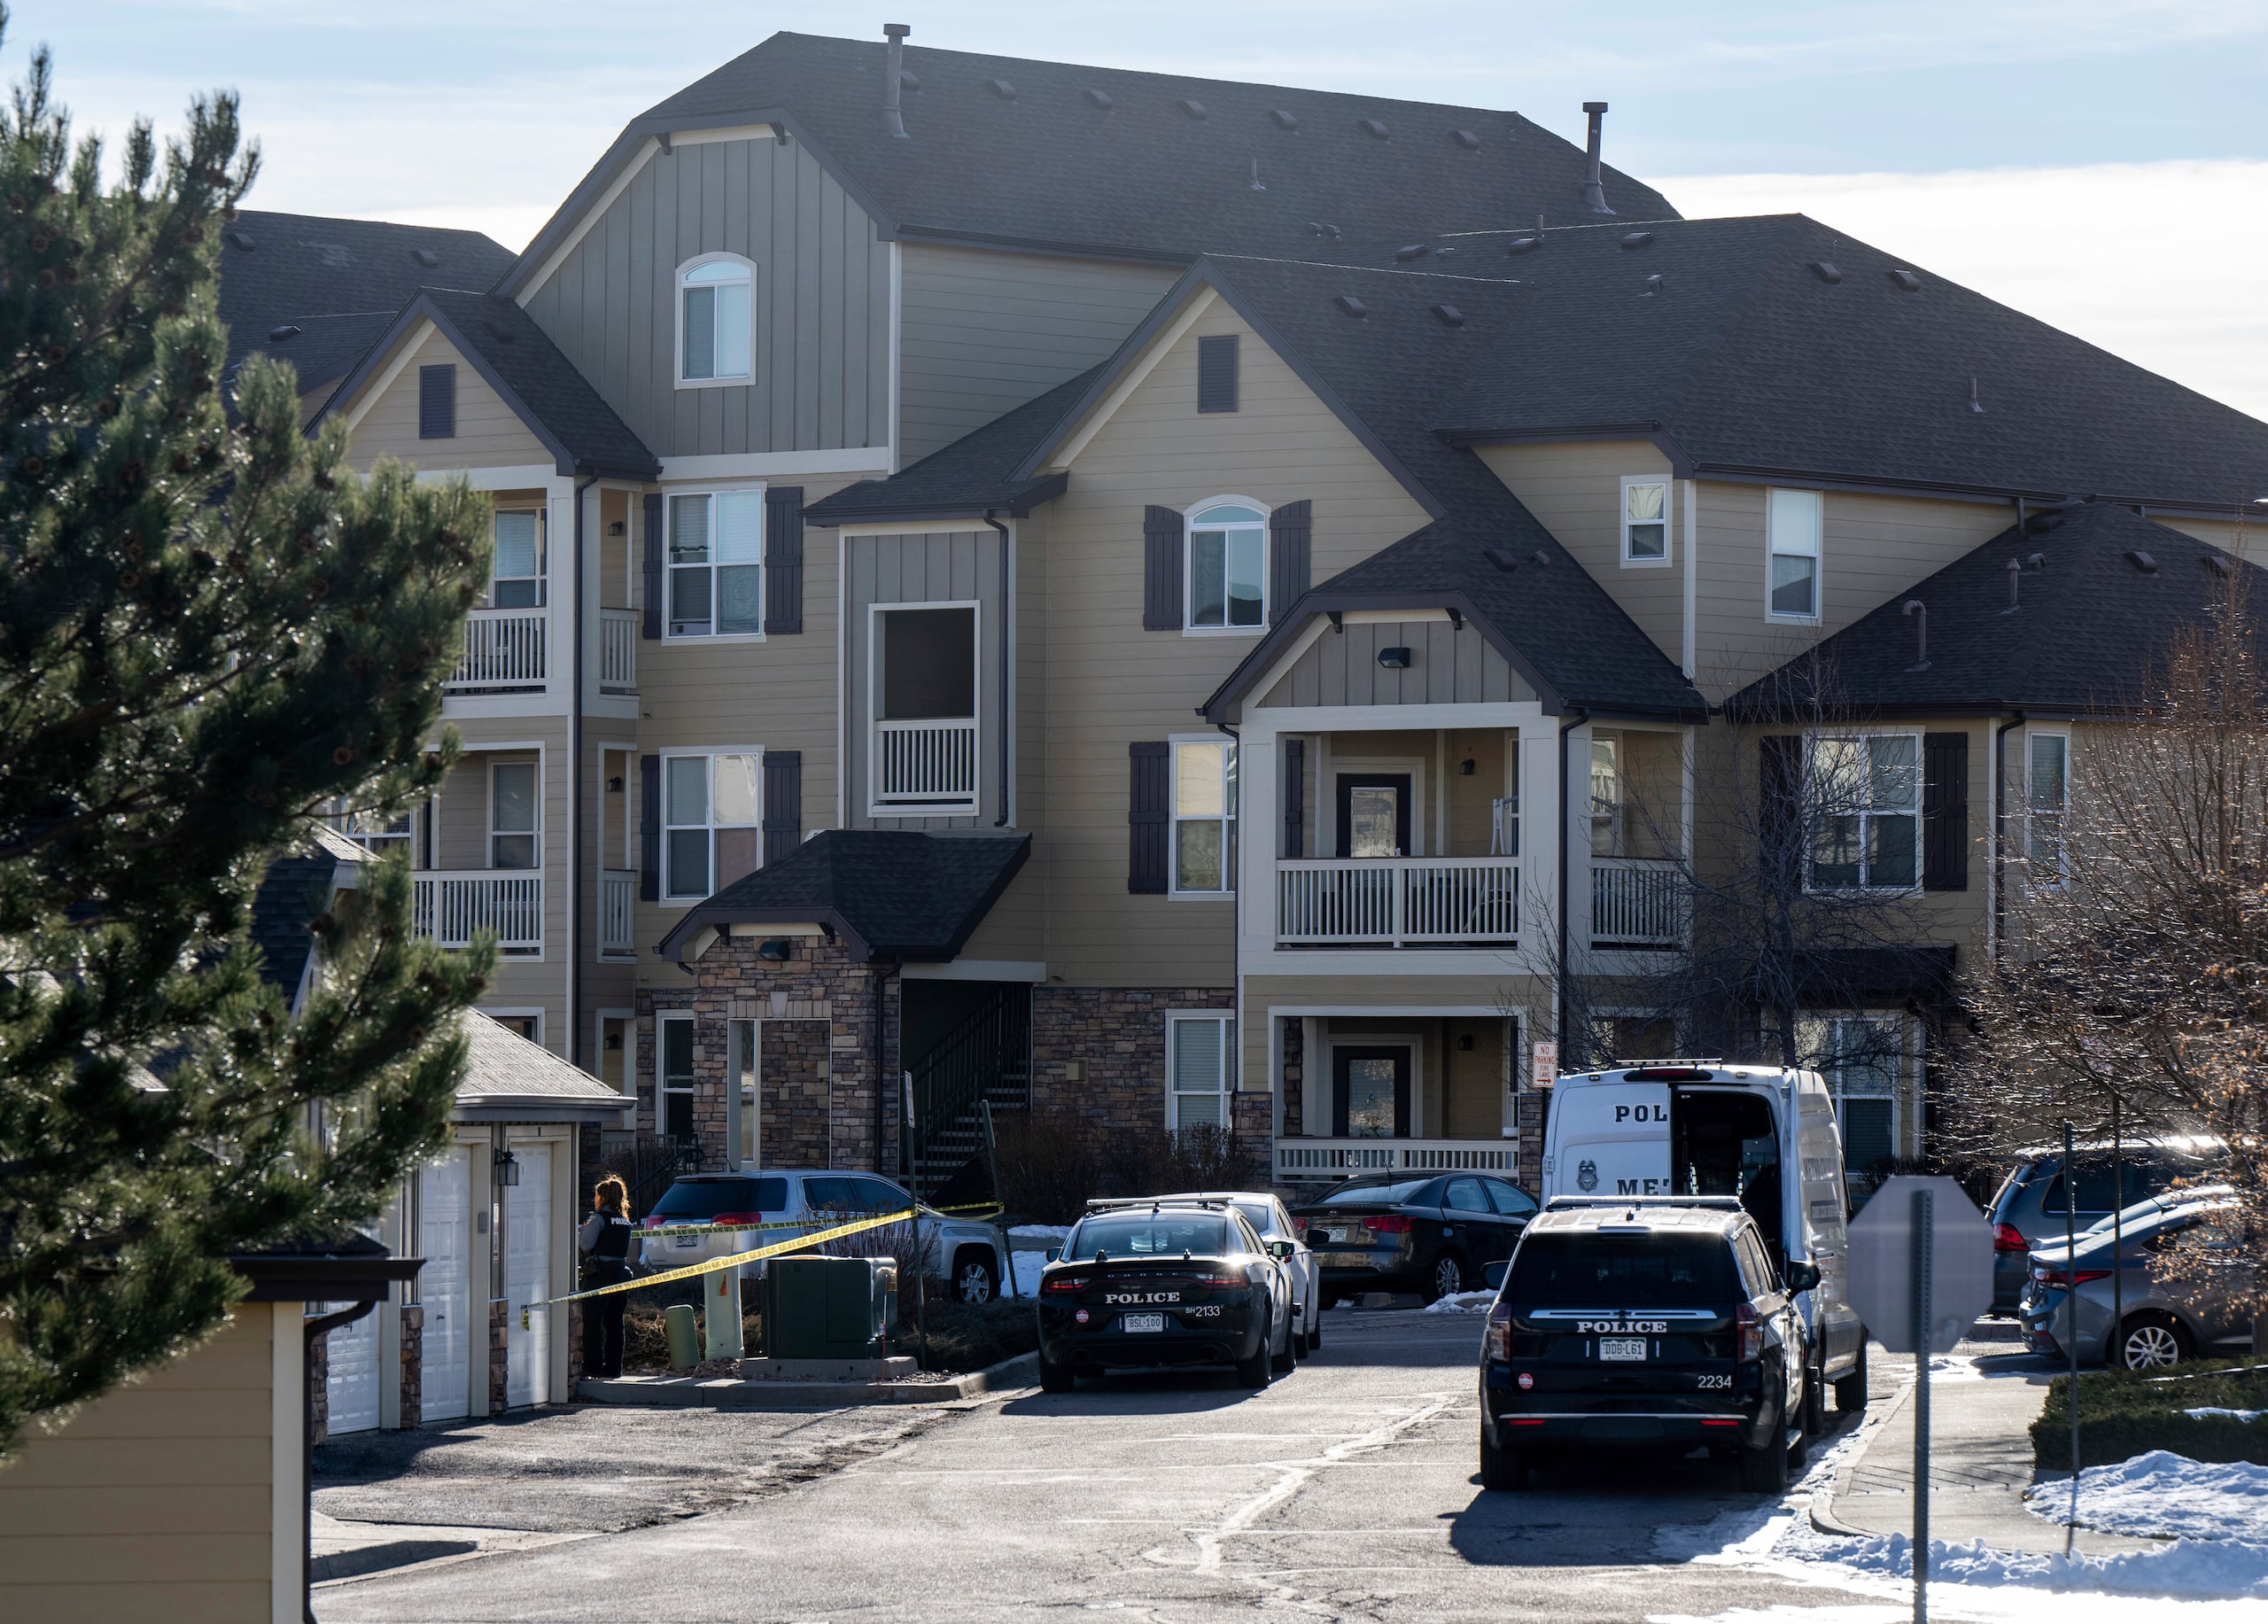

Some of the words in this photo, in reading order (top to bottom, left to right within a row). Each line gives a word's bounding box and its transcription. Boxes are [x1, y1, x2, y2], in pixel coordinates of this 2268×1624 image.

[1615, 1105, 1667, 1123] POL
[1105, 1292, 1180, 1304] POLICE
[1196, 1305, 1220, 1317] 2133
[1577, 1321, 1667, 1333] POLICE
[1697, 1375, 1732, 1388] 2234
